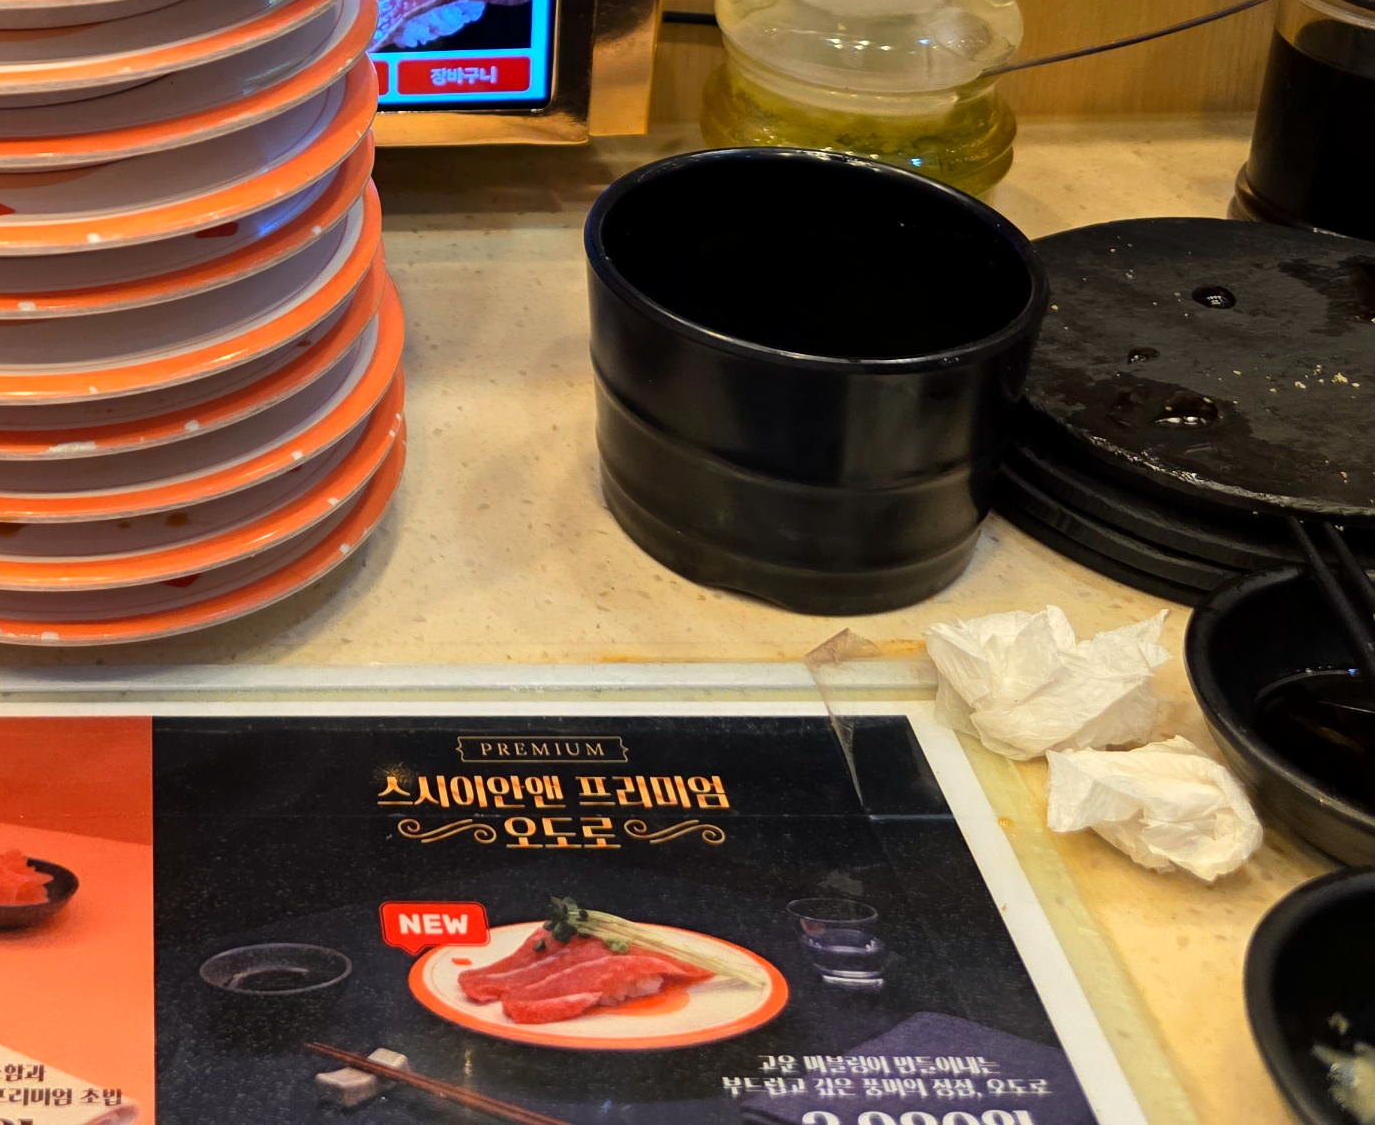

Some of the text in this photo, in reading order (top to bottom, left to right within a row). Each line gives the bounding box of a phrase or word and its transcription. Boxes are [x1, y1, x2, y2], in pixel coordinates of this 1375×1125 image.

[430, 65, 498, 87] 장바구니
[480, 741, 606, 757] PREMIUM
[377, 775, 731, 809] 스시이안앤 프리미엄
[504, 816, 622, 849] 오도로
[398, 913, 469, 935] NEW
[79, 1087, 125, 1107] 초밥
[986, 1078, 1054, 1096] 오도로
